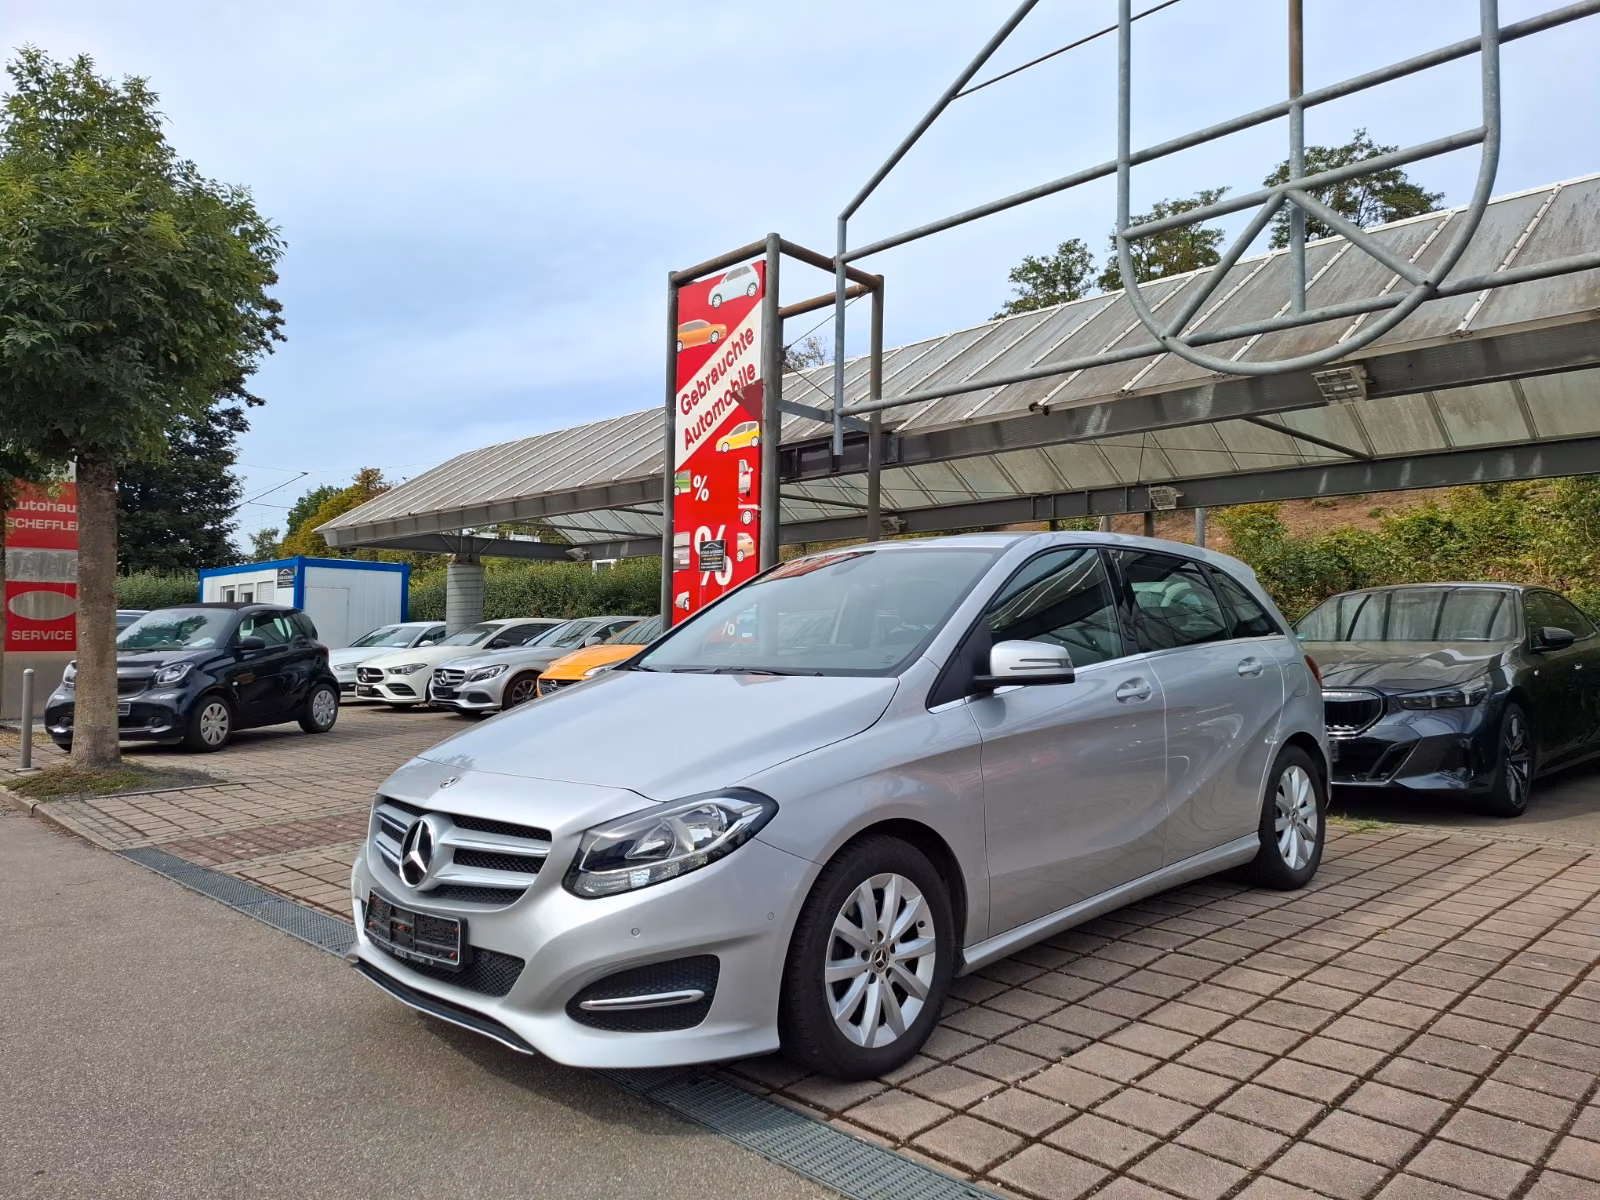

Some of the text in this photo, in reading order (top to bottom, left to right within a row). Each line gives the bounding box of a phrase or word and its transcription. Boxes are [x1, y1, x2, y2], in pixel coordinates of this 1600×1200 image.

[680, 327, 754, 415] Gebrauchte
[684, 363, 756, 451] Automobile
[693, 475, 709, 501] %
[16, 500, 77, 513] utohau
[5, 517, 79, 531] SCHEFFLE
[12, 630, 73, 641] SERVICE
